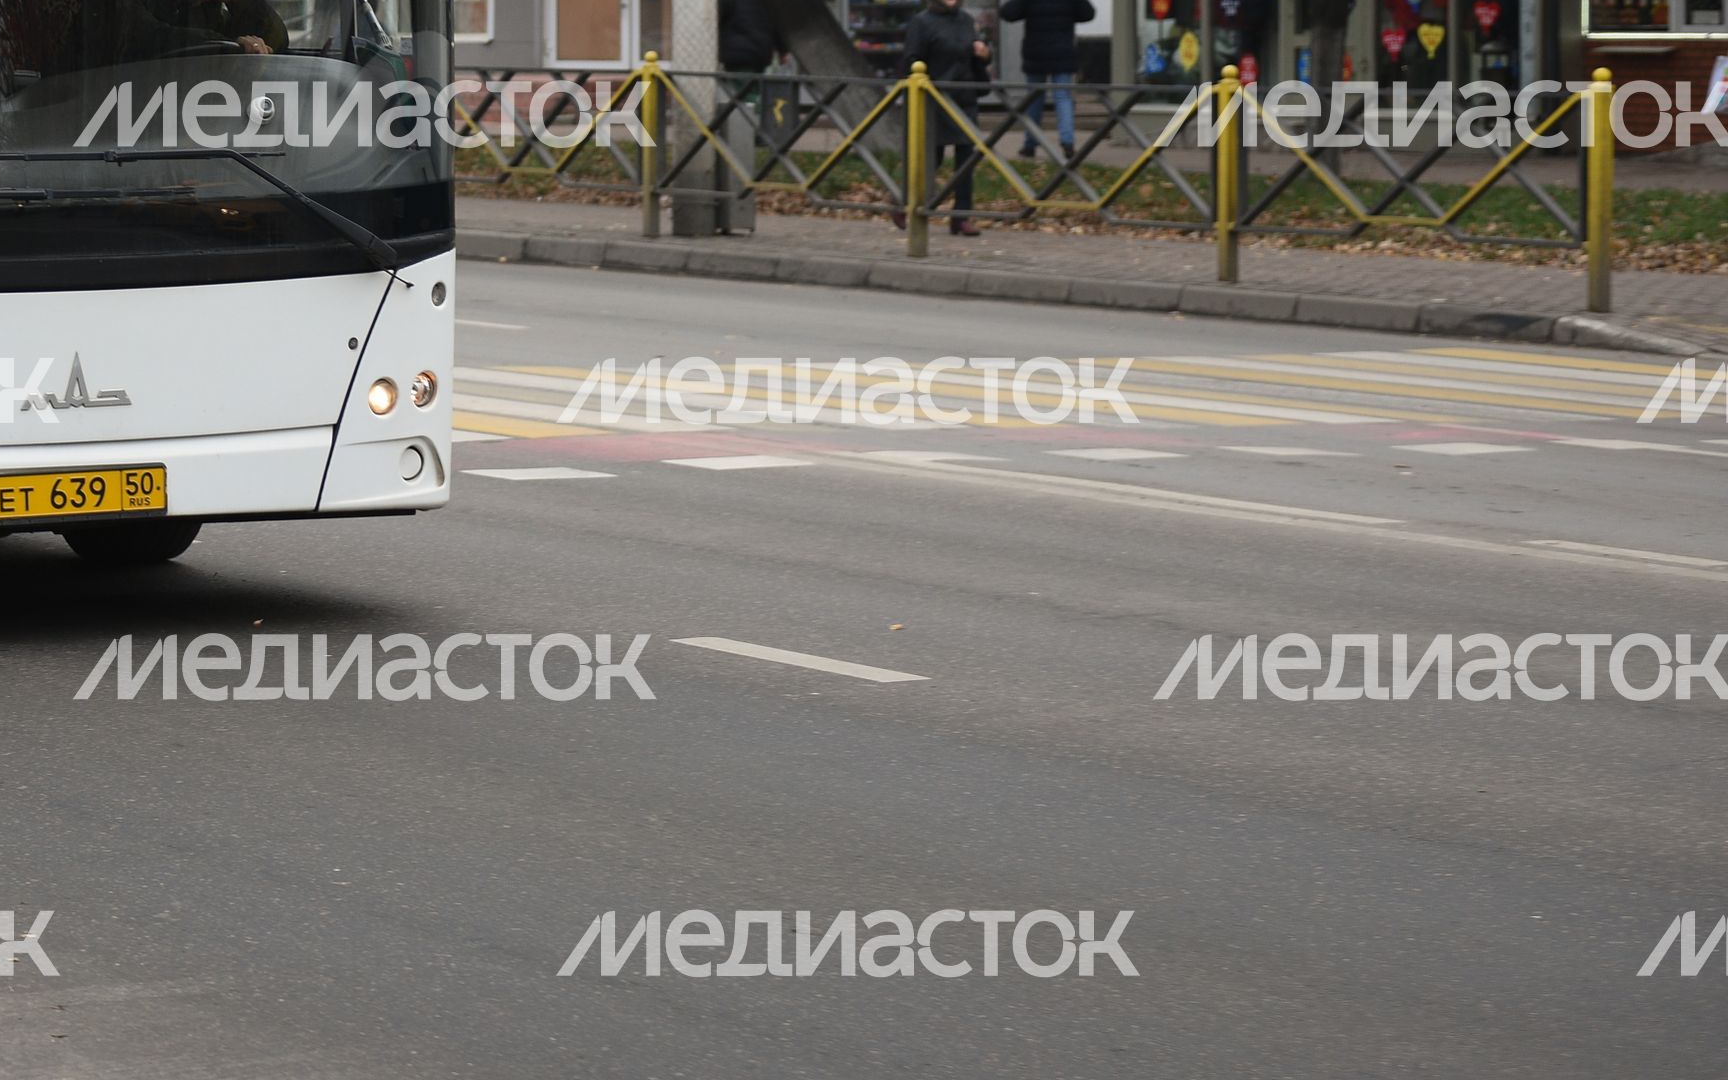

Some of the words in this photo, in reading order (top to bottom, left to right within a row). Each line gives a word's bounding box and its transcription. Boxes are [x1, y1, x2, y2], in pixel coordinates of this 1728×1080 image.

[50, 476, 106, 510] 639
[125, 472, 154, 495] 50
[129, 497, 151, 507] RUS
